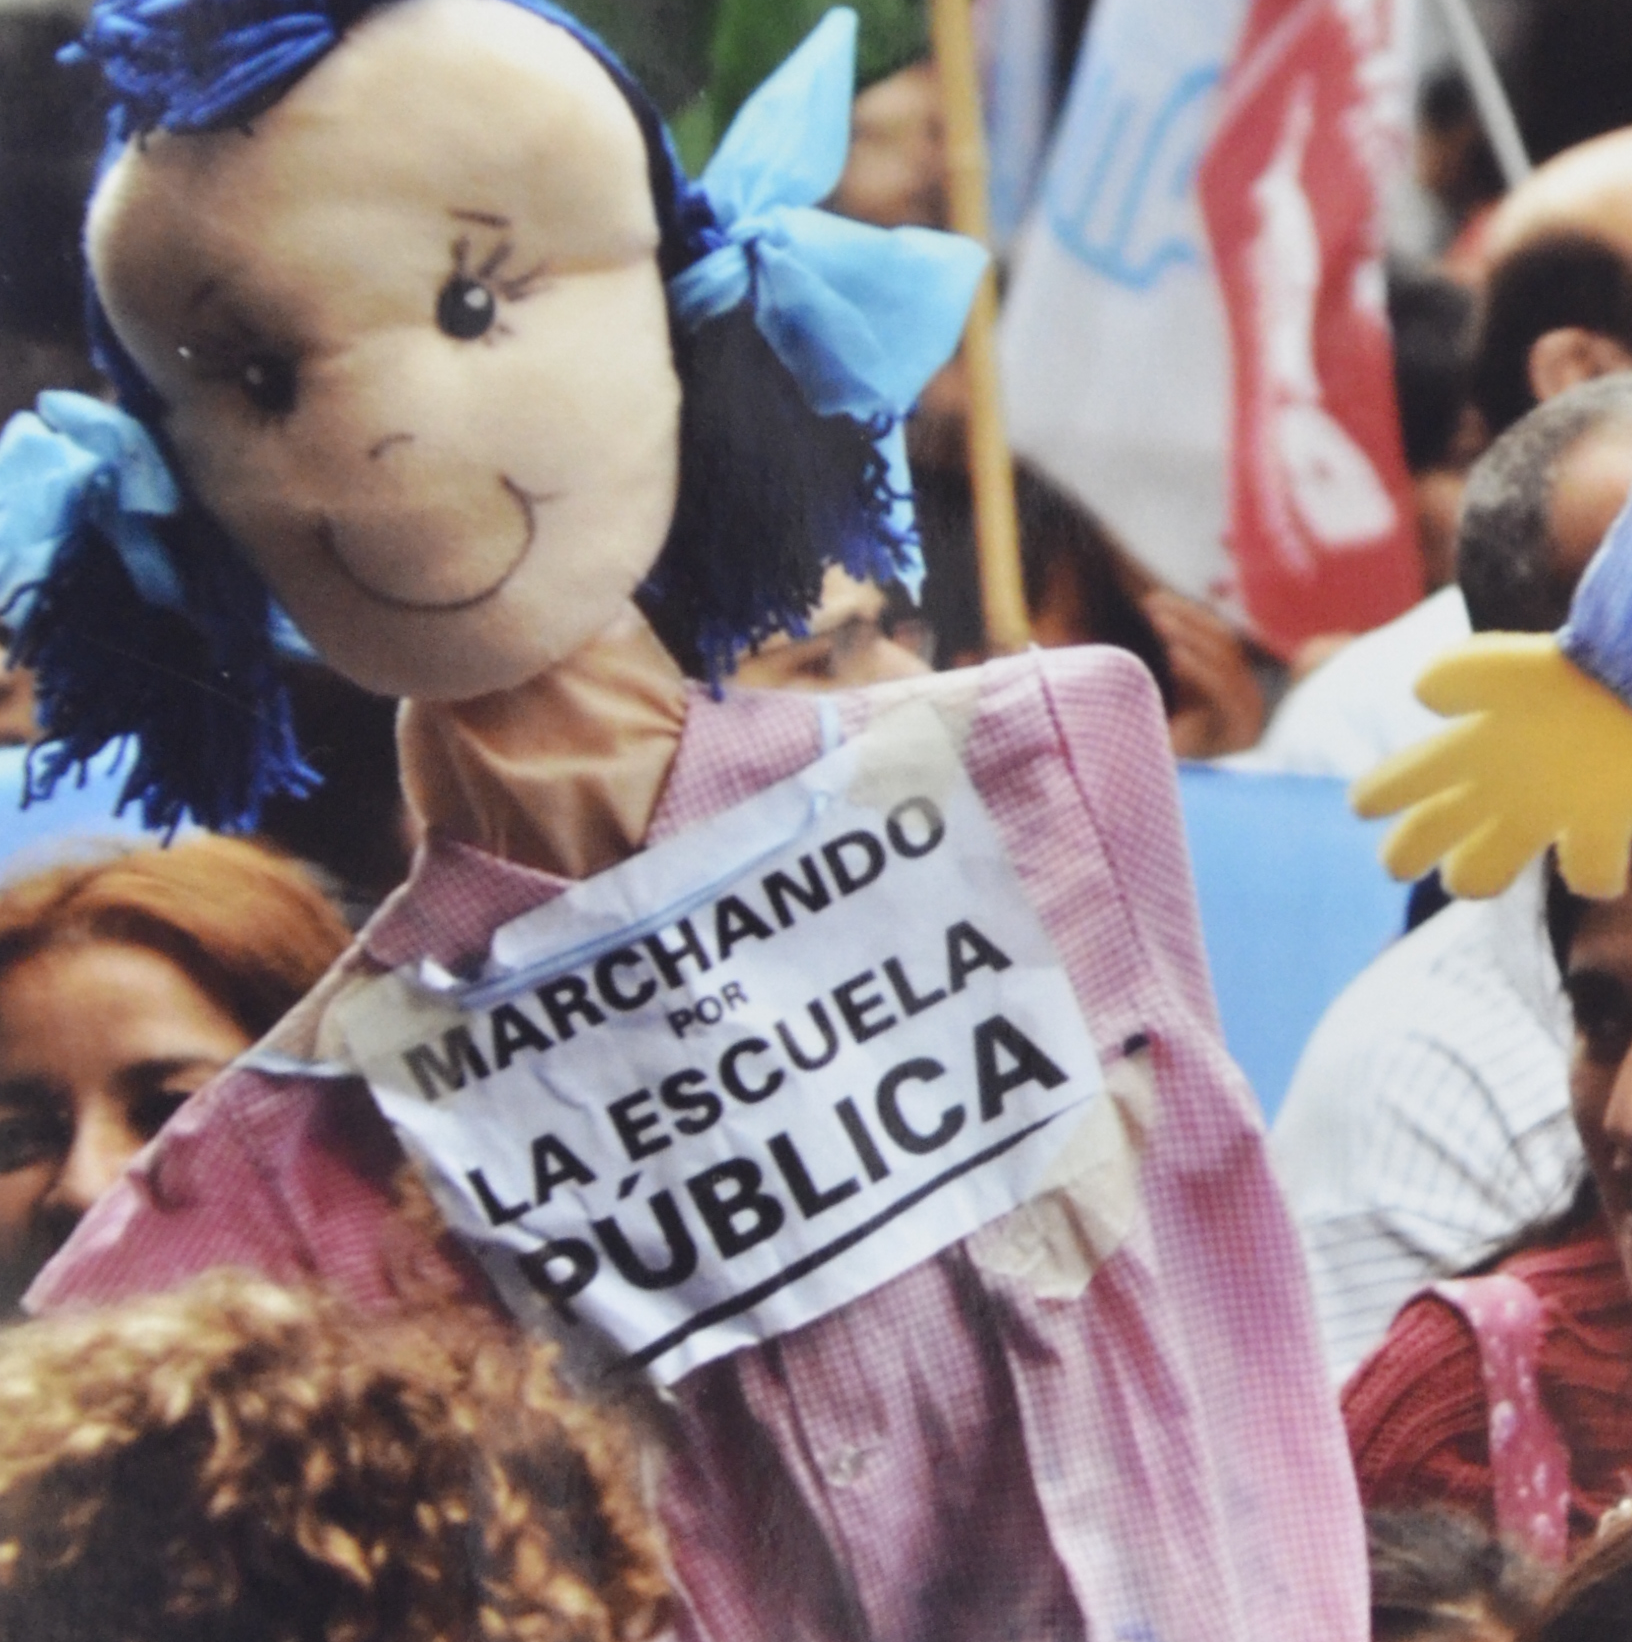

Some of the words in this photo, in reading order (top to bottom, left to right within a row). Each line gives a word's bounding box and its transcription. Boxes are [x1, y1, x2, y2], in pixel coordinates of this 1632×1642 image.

[403, 796, 945, 1099] MARCHANDO
[467, 1133, 596, 1228] LA
[607, 921, 1013, 1163] ESCUELA
[668, 981, 748, 1038] POR
[516, 1015, 1070, 1327] PÚBLICA
